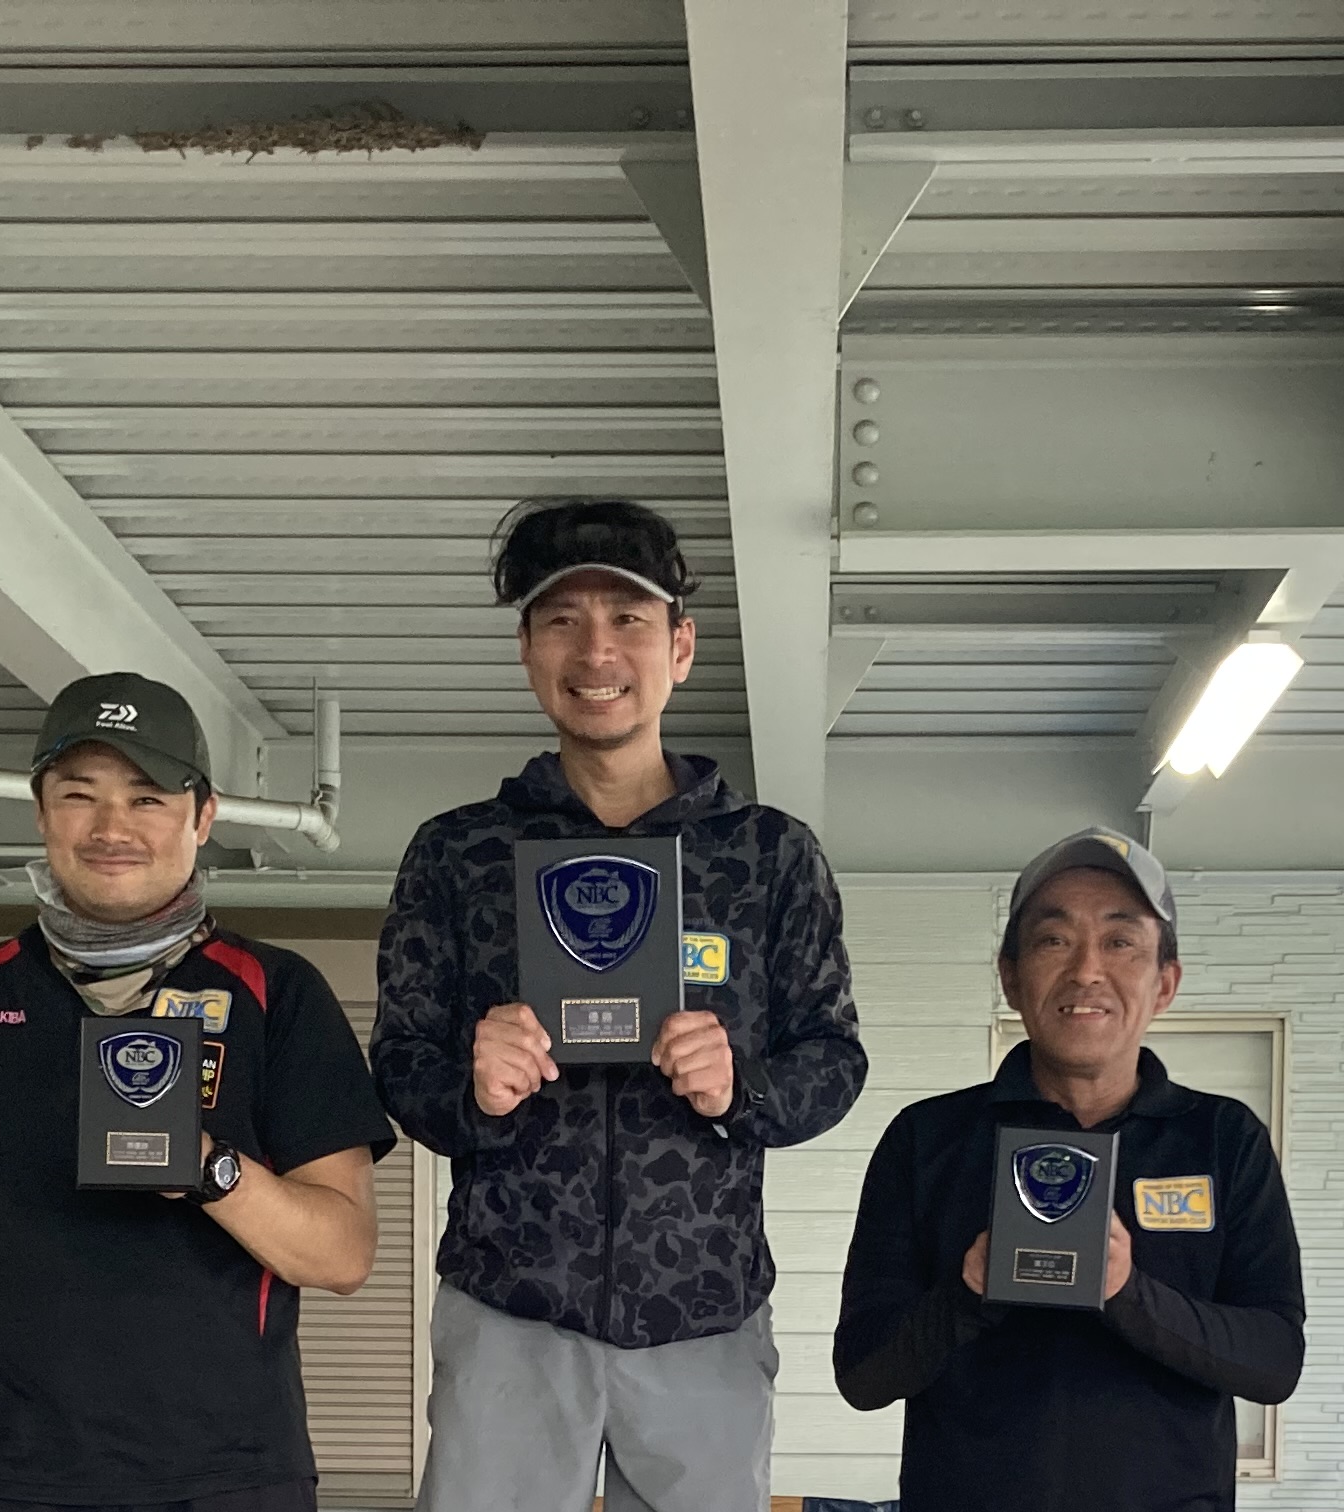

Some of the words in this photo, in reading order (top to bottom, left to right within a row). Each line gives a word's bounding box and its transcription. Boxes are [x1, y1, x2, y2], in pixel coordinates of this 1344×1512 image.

[576, 884, 619, 904] NBC
[682, 942, 720, 971] BC
[125, 1050, 156, 1063] NBC
[1142, 1188, 1206, 1217] NBC
